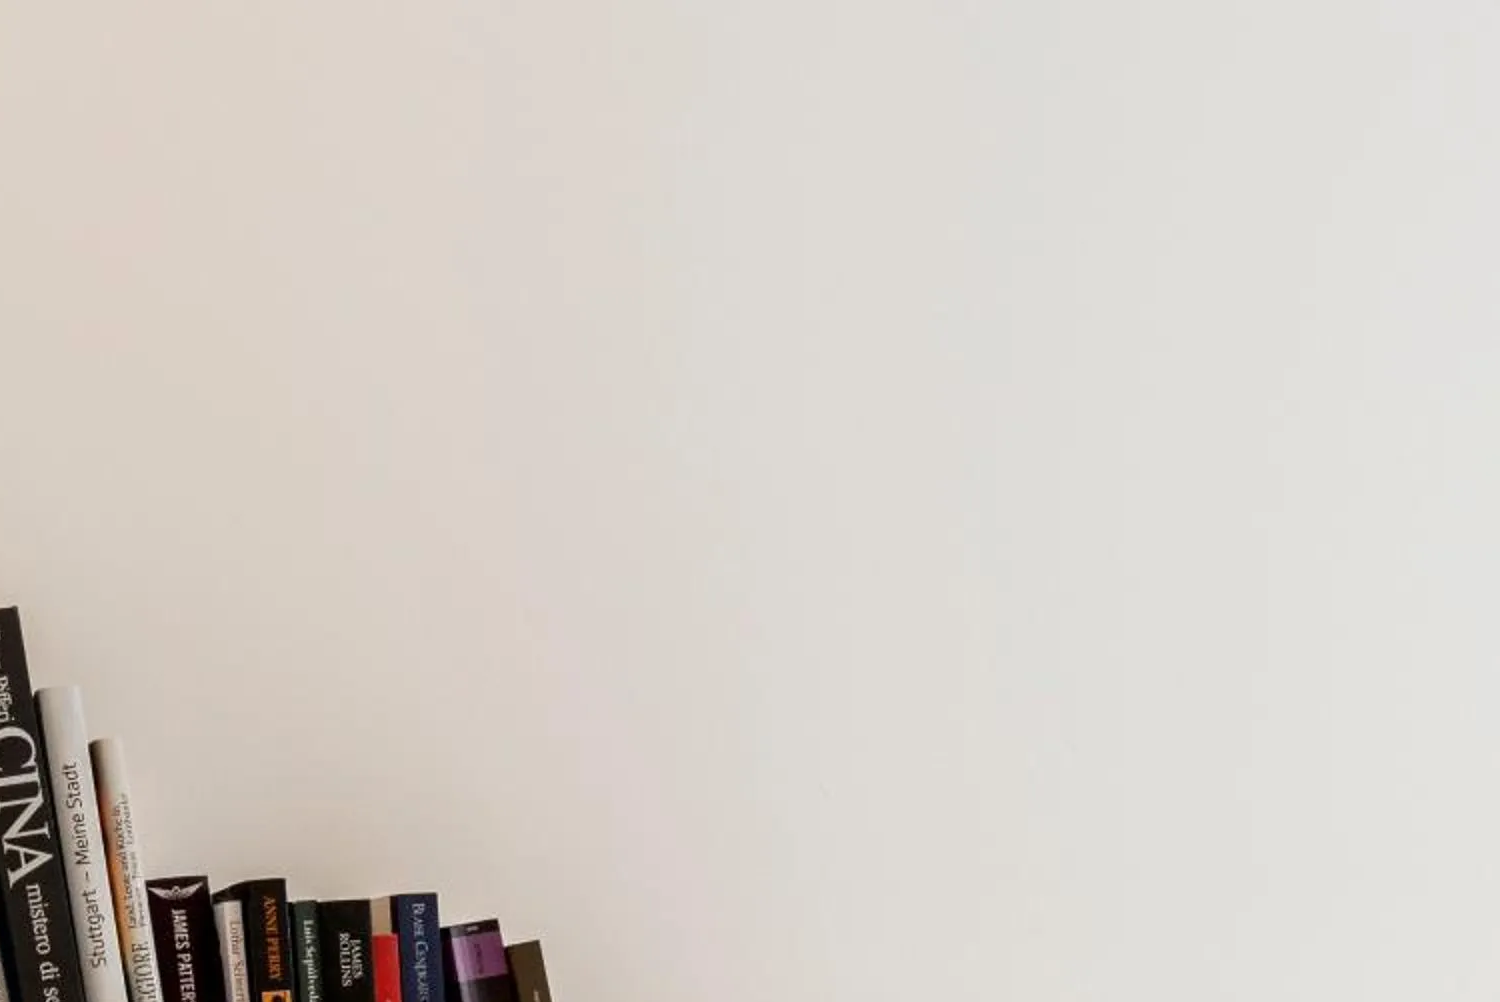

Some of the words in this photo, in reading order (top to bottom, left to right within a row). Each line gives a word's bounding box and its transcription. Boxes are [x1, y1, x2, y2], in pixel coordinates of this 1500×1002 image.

[62, 761, 83, 810] Stadt
[69, 814, 90, 866] Meine
[26, 884, 51, 955] mistero
[40, 962, 60, 981] di
[82, 889, 106, 969] Stuttgart
[171, 908, 190, 950] JAMES
[263, 896, 280, 935] ANNE
[303, 919, 315, 944] Luis
[339, 933, 352, 988] ROLLINS
[351, 938, 364, 980] JAMES
